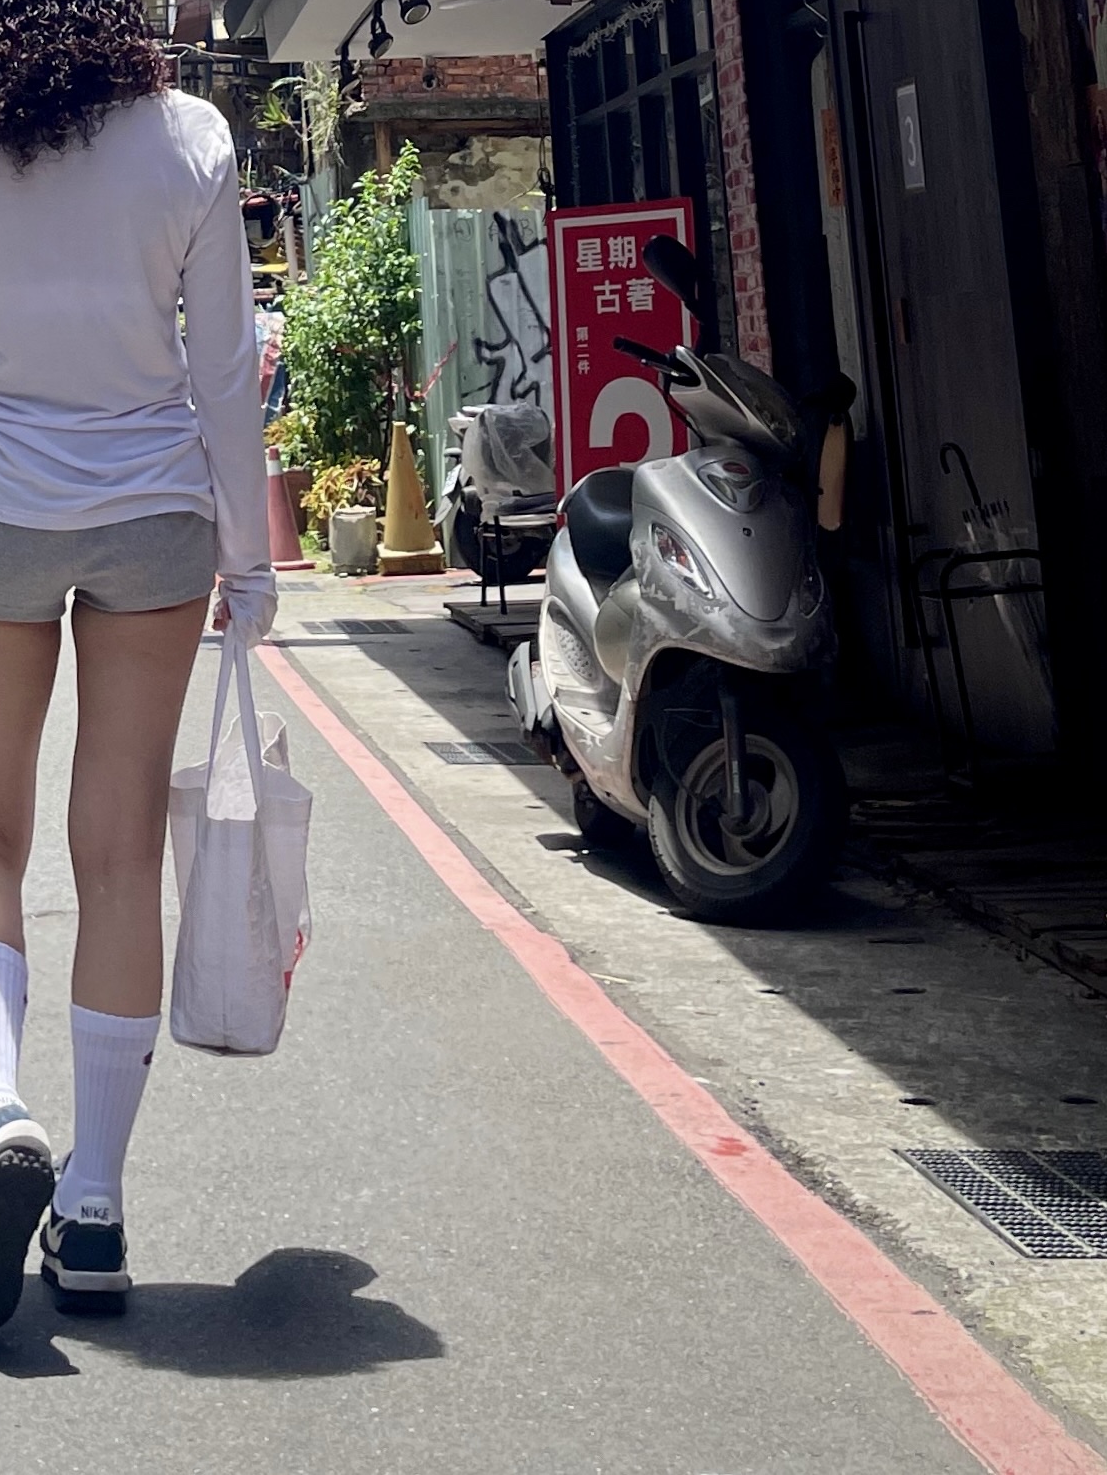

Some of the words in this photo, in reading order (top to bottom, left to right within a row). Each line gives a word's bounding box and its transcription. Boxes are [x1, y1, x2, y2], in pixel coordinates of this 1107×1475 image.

[576, 236, 644, 273] 星期
[593, 277, 655, 315] 古著
[575, 326, 591, 376] 第二件
[81, 1205, 110, 1221] NIKE
